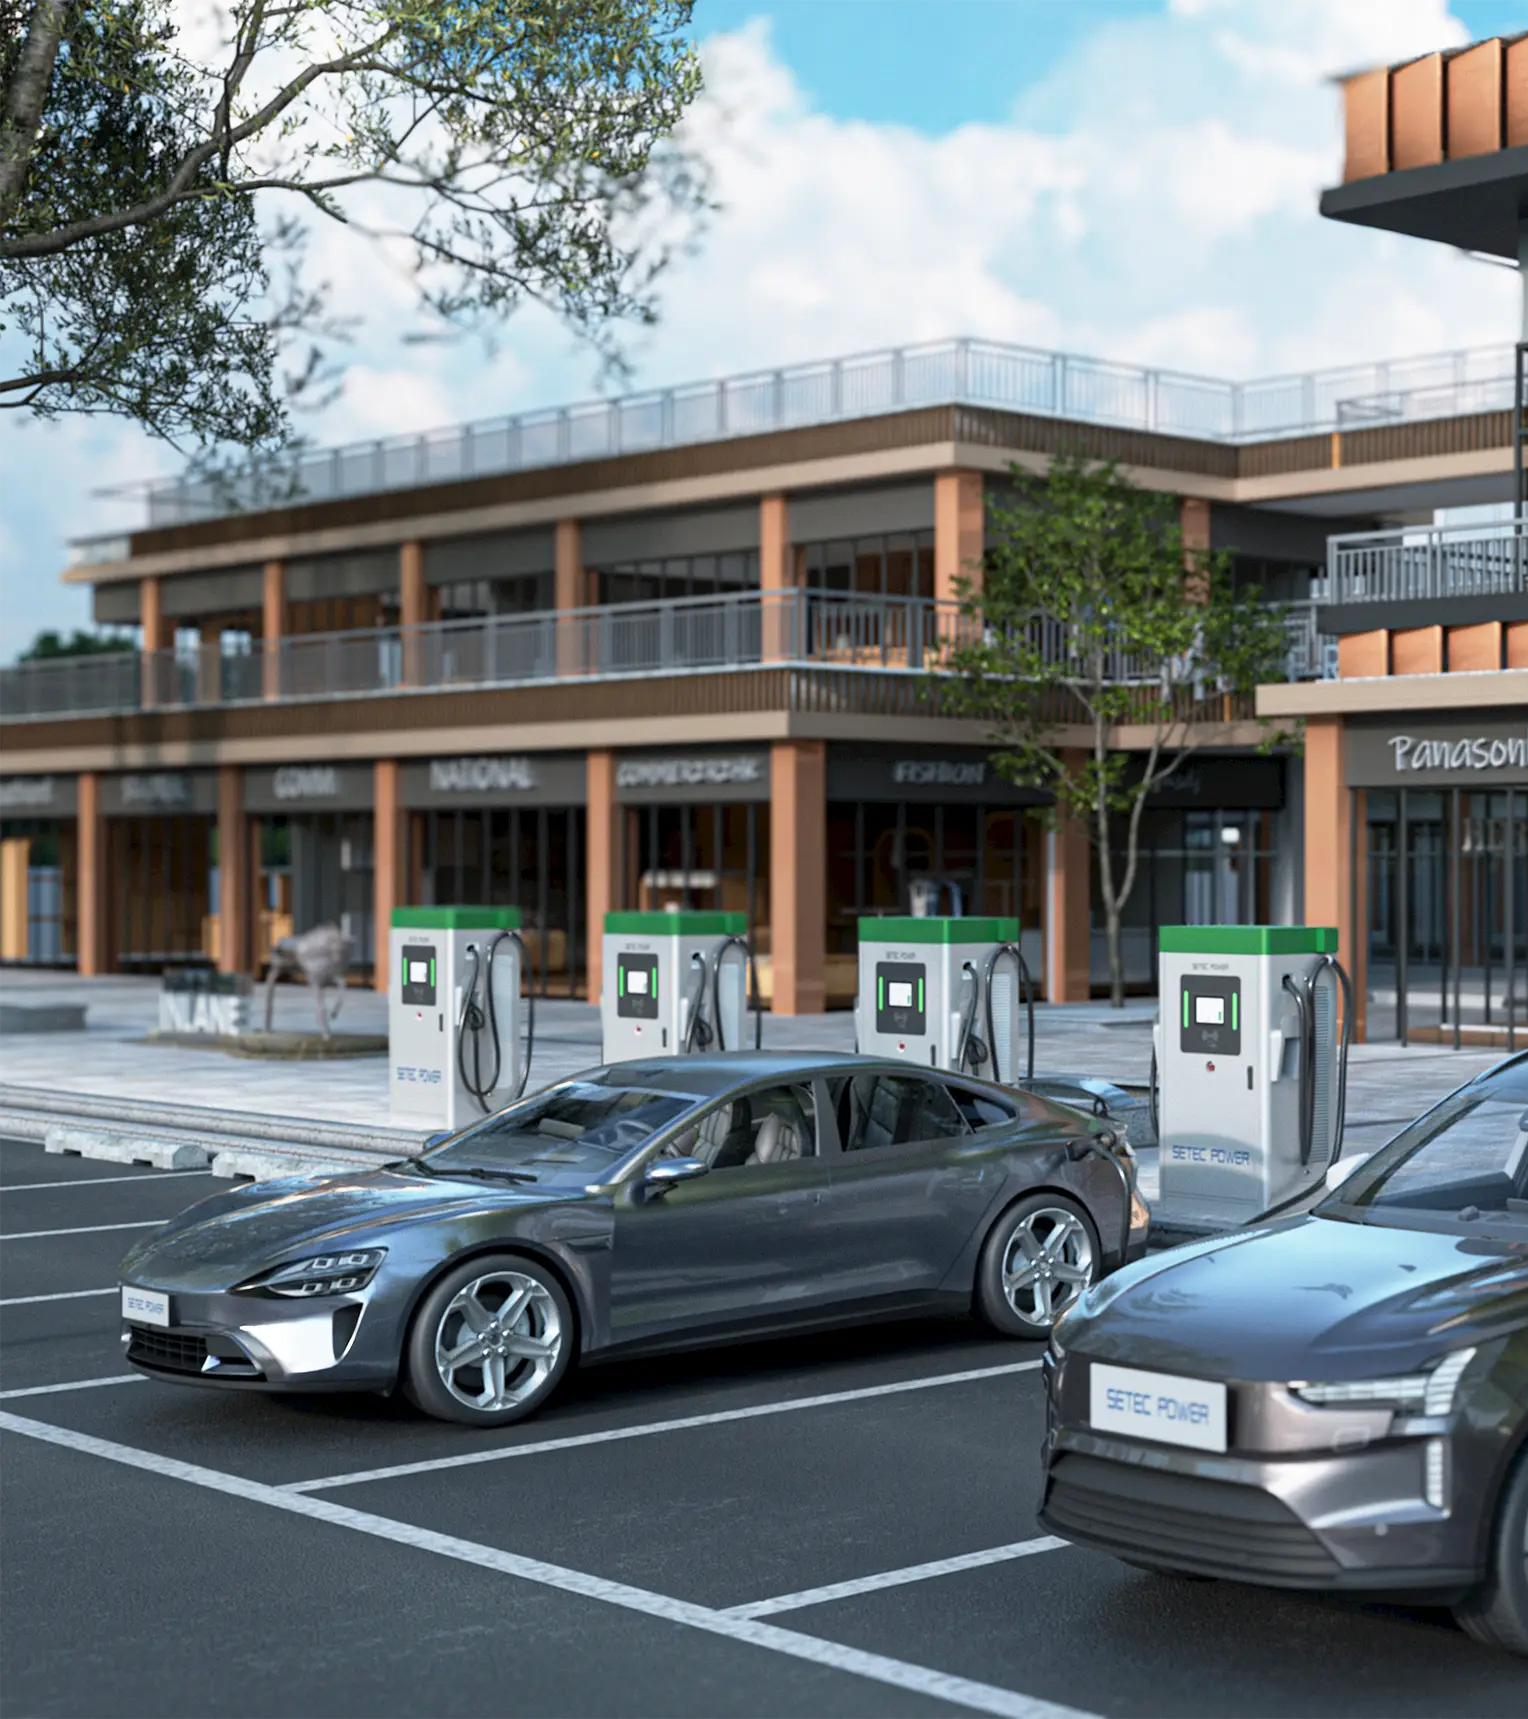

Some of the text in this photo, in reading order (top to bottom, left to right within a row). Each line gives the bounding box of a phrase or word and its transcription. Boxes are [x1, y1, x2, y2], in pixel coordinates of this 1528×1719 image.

[1172, 1144, 1250, 1165] SETEC POWER
[1106, 1387, 1209, 1425] SETEC POWER
